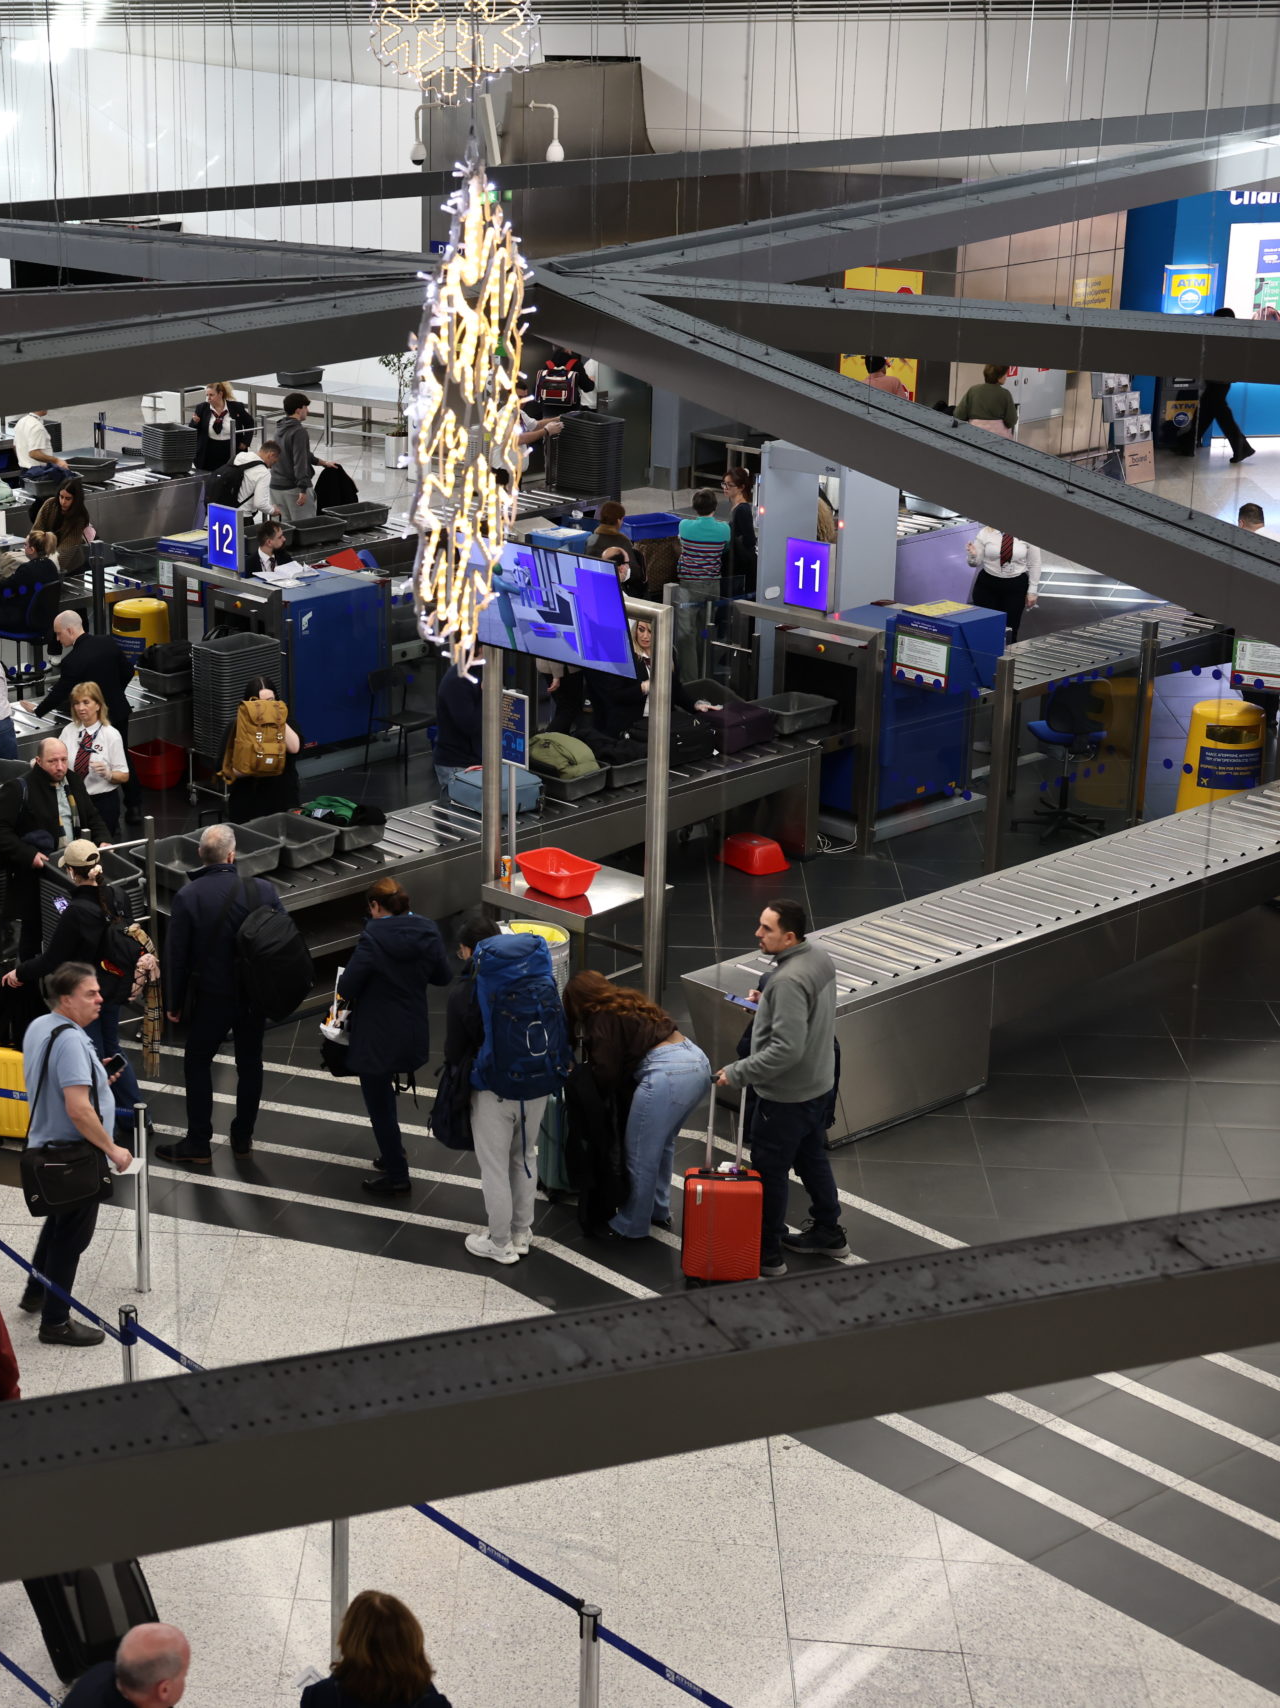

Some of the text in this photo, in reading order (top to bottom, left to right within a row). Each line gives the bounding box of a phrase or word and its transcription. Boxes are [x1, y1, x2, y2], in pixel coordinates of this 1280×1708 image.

[1177, 279, 1206, 288] ATM
[212, 521, 234, 555] 12
[794, 557, 821, 593] 11
